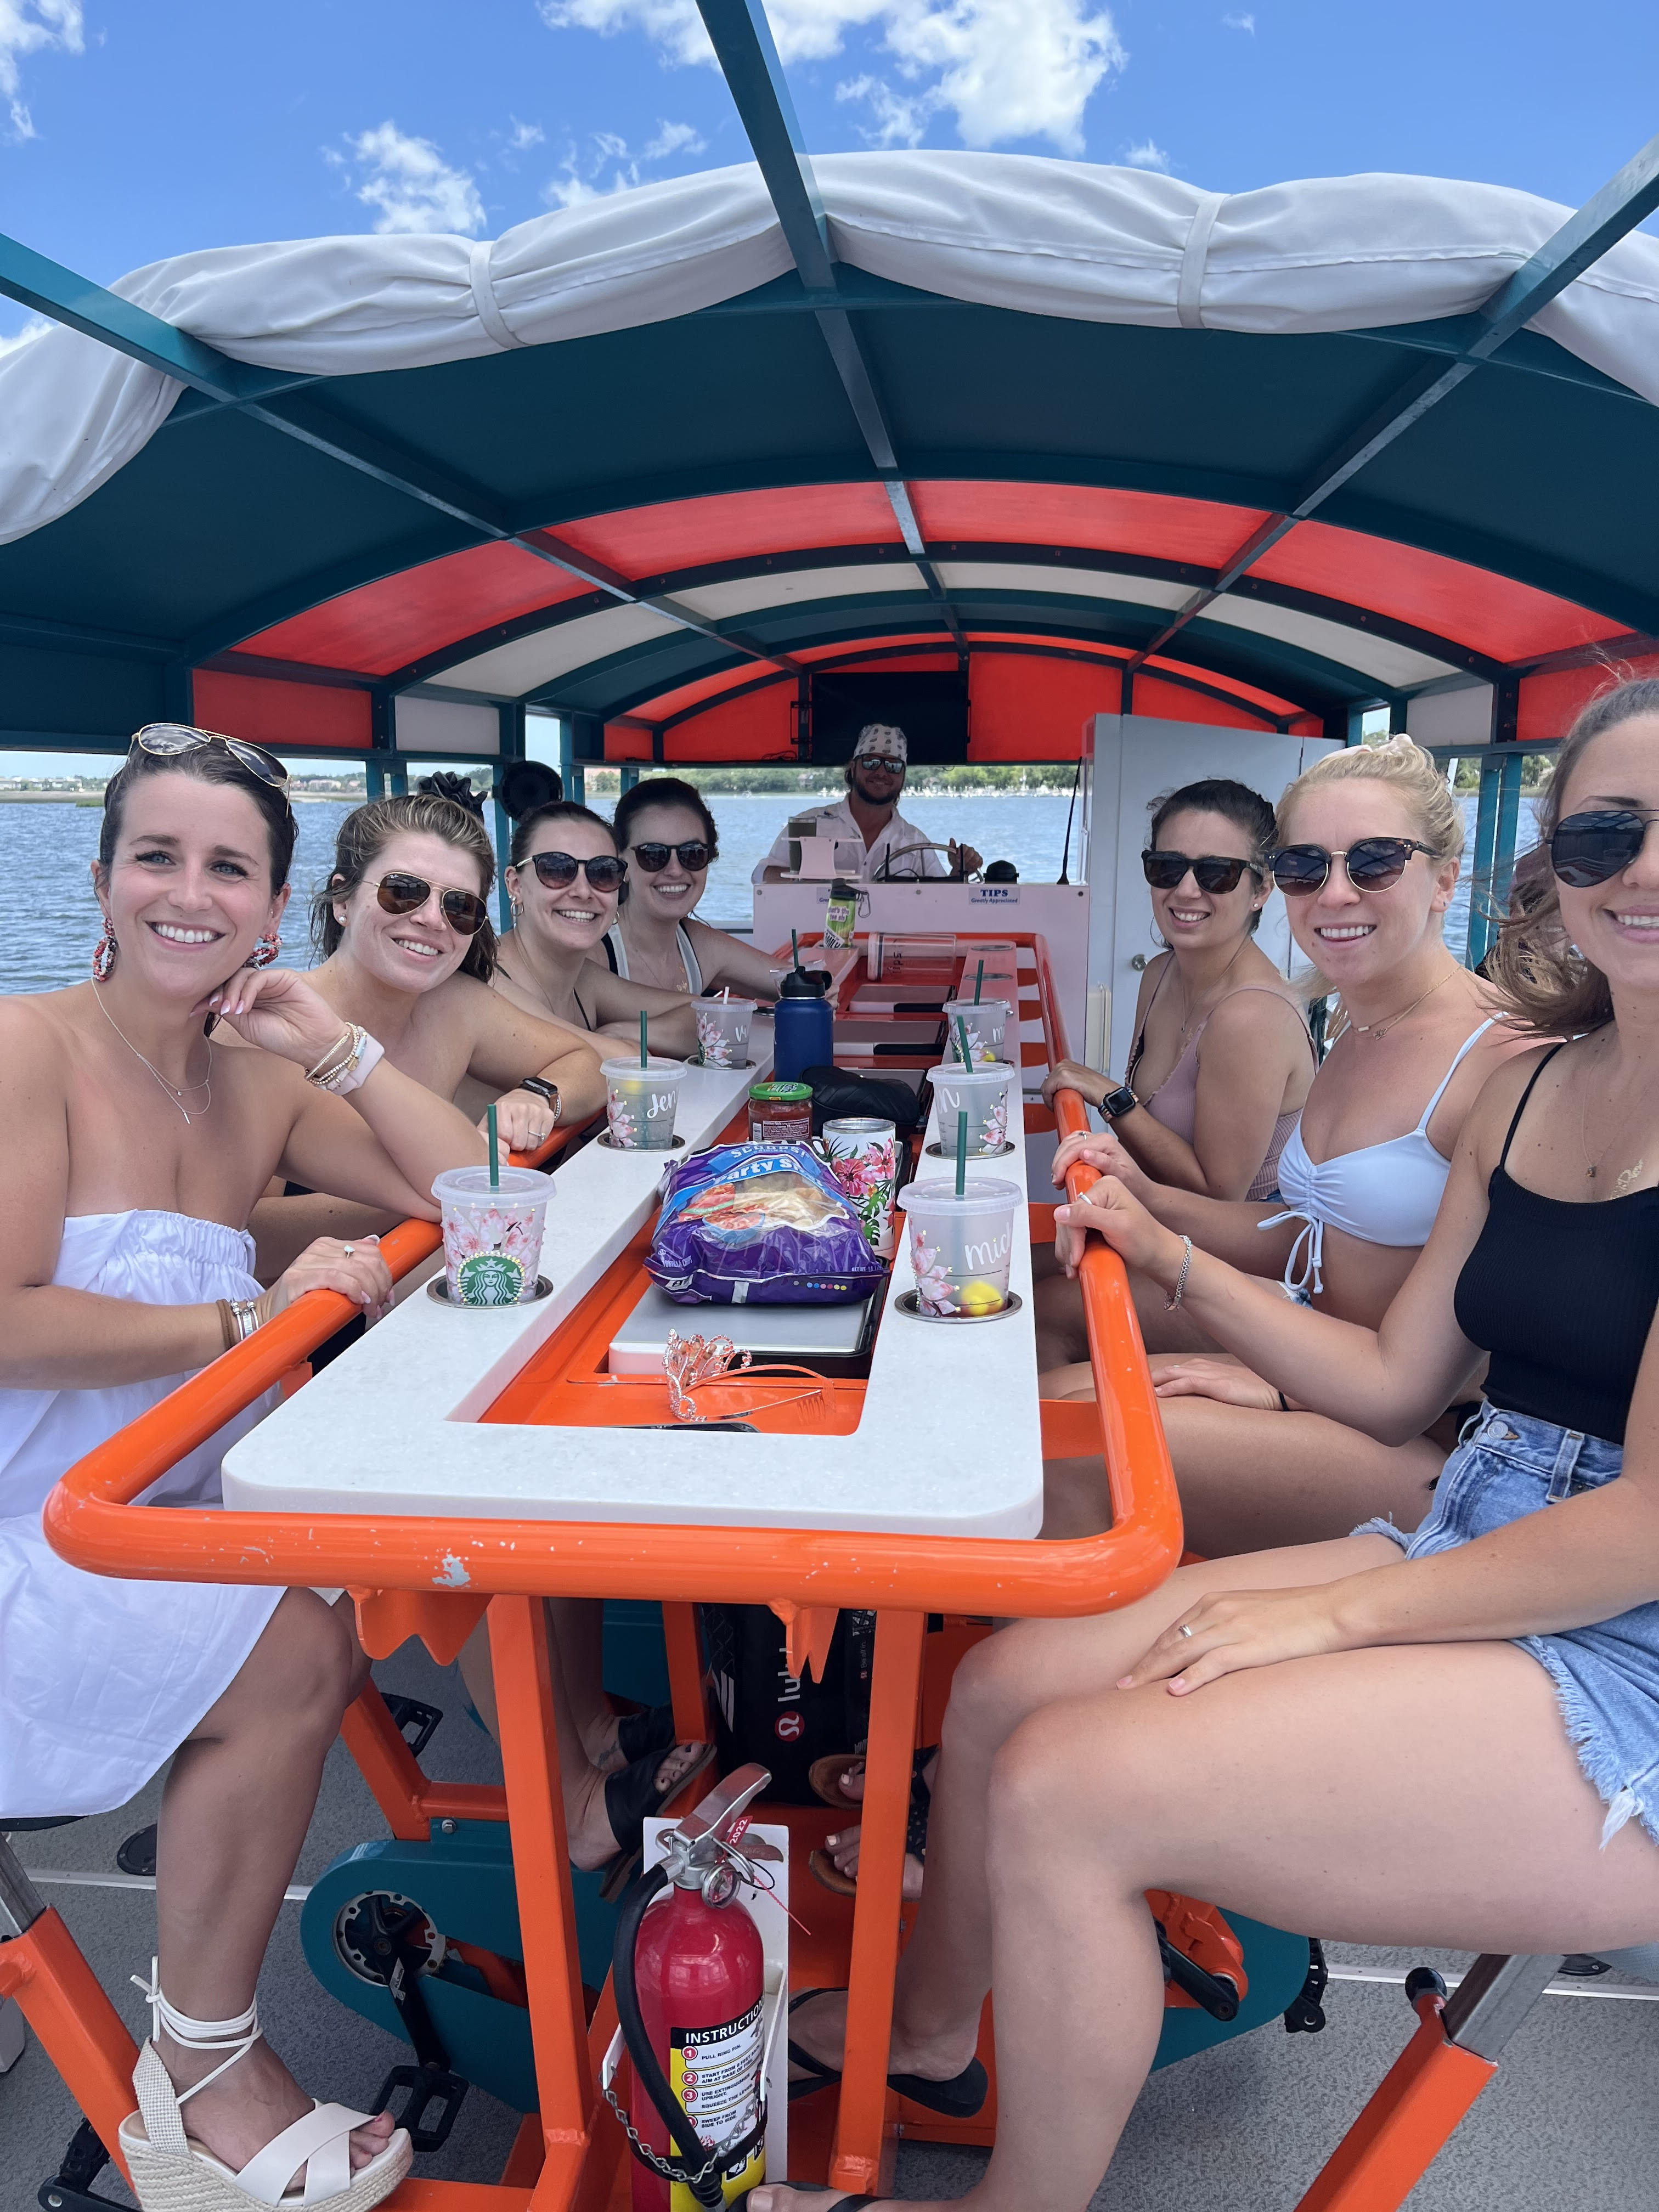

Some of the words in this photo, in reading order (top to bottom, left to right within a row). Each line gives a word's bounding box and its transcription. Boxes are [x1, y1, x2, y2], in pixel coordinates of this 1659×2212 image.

[731, 1145, 806, 1158] SCOOPS!
[713, 1160, 774, 1185] Party
[729, 1819, 748, 1845] 2022
[686, 2074, 693, 2083] 2
[721, 2065, 736, 2074] FROM
[723, 2070, 736, 2079] BASE
[702, 2099, 727, 2109] SQUEEZE
[729, 2093, 738, 2102] THE
[722, 2110, 736, 2119] FROM
